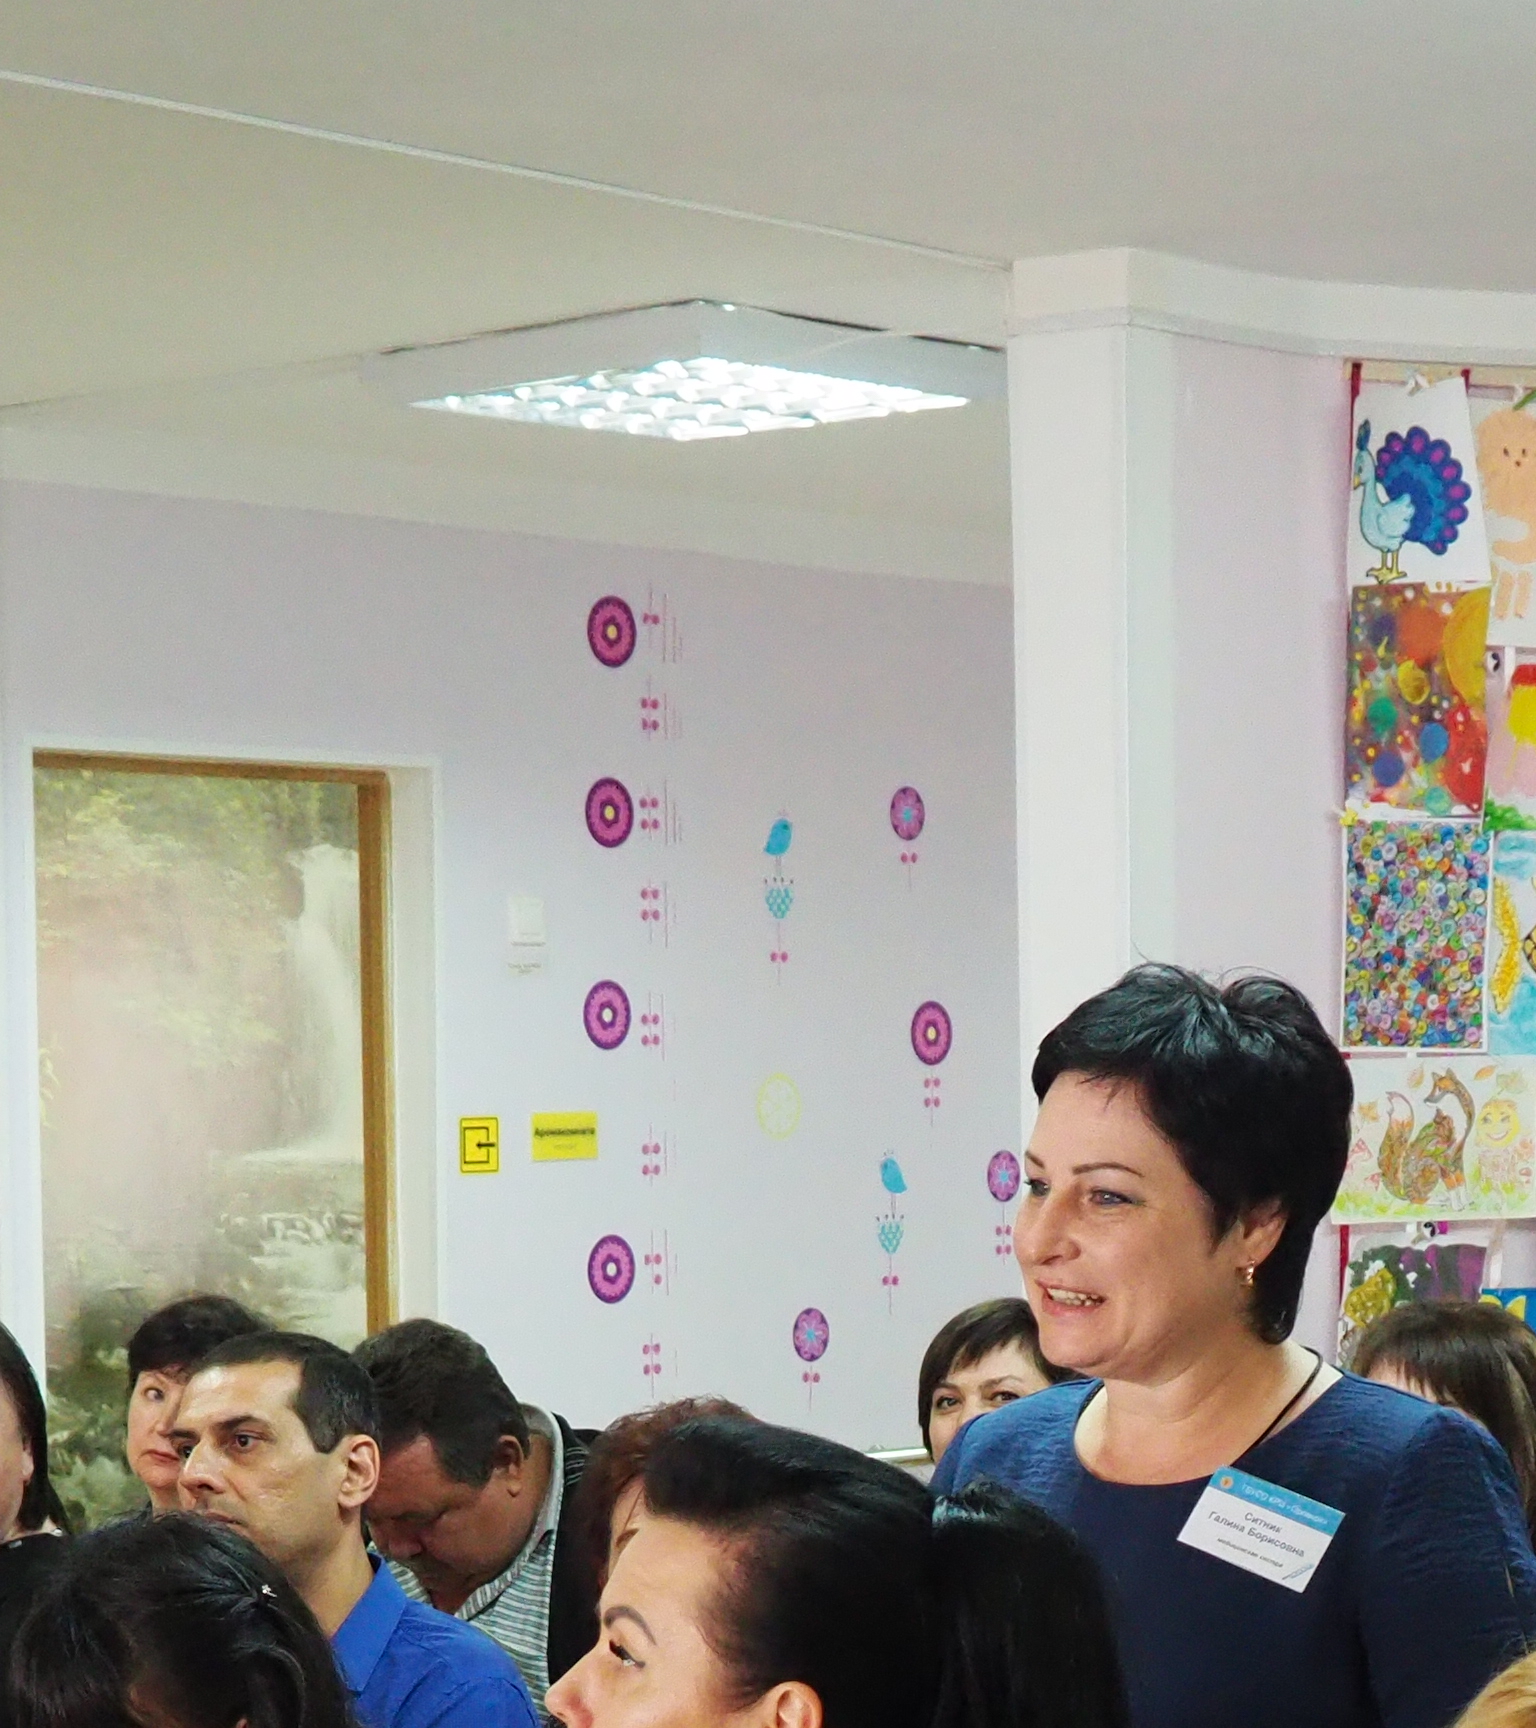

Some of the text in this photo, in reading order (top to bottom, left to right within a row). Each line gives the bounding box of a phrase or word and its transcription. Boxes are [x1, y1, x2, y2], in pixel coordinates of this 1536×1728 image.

[1208, 1511, 1305, 1558] Галина Борисовна
[1244, 1512, 1282, 1534] Ситник
